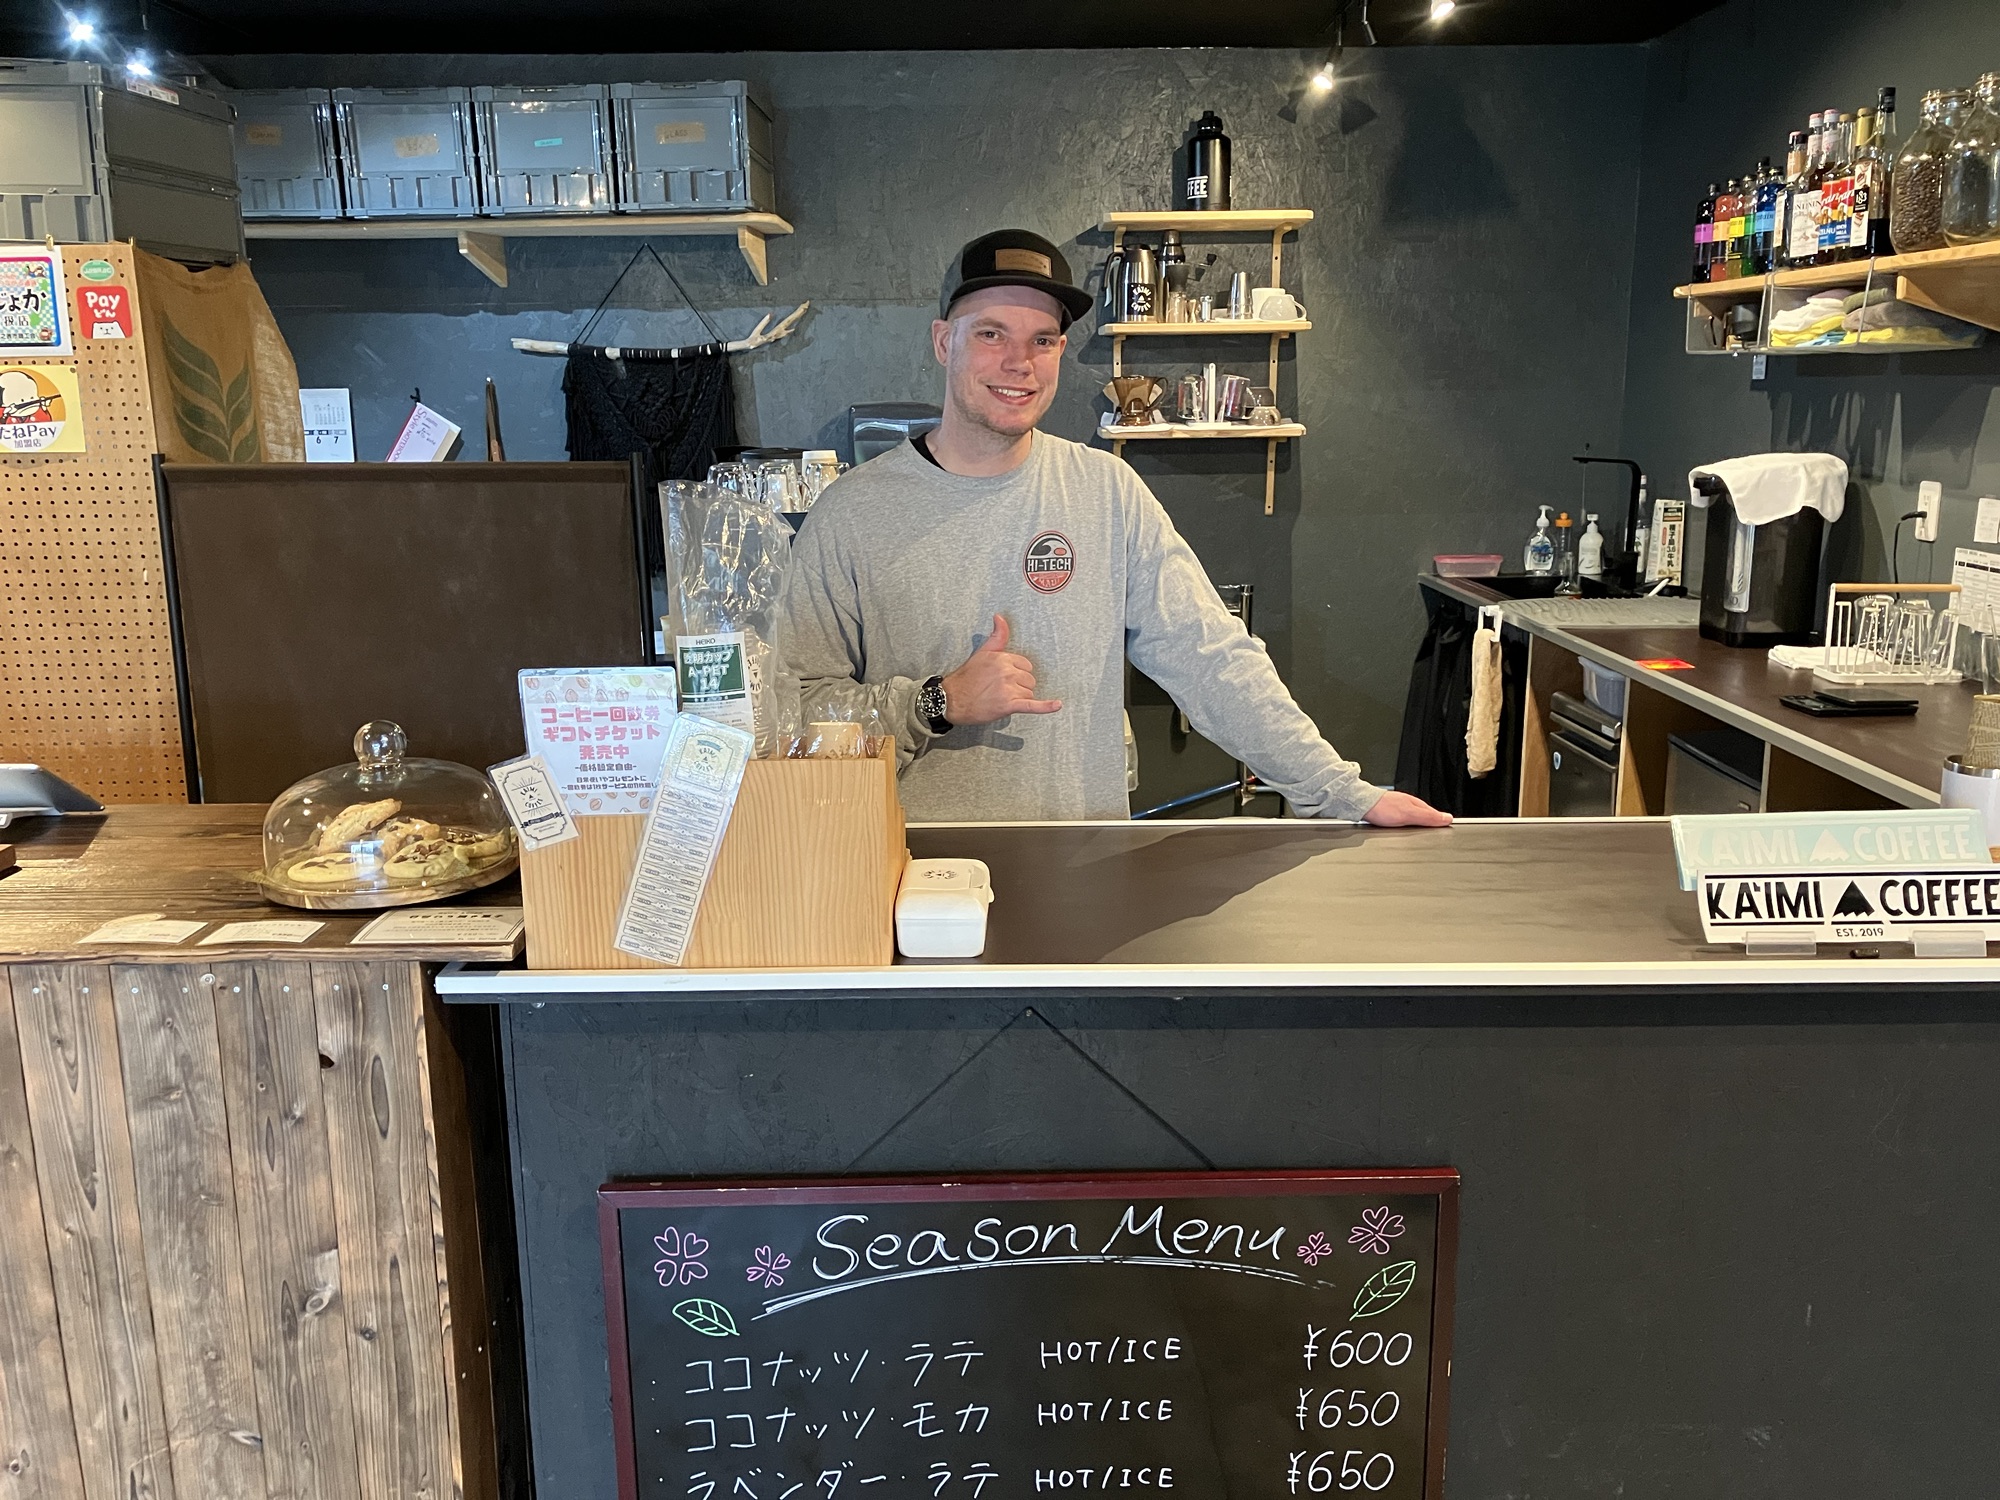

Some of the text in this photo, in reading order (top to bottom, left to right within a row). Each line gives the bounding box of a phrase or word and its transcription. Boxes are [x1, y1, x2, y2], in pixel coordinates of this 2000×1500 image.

[85, 291, 120, 310] Pay
[93, 308, 116, 319] どん
[1027, 558, 1072, 572] HI-TECH
[695, 637, 716, 646] HEIKO
[700, 676, 720, 691] 14
[540, 705, 661, 724] コーヒー回数券
[543, 724, 661, 743] ギフトチケット
[579, 744, 630, 761] 発売中
[1852, 824, 1978, 862] COFFEE
[1878, 878, 2000, 918] COFFEE
[1835, 928, 1885, 938] EST. 2019
[812, 1204, 1287, 1280] Season Menu
[1039, 1336, 1183, 1370] HOT/ICE
[1302, 1323, 1414, 1371] ¥600
[1037, 1397, 1174, 1427] HOT/ICE
[1294, 1387, 1401, 1431] ¥650
[1034, 1465, 1175, 1493] HOT/ICE
[1286, 1449, 1396, 1495] ¥650
